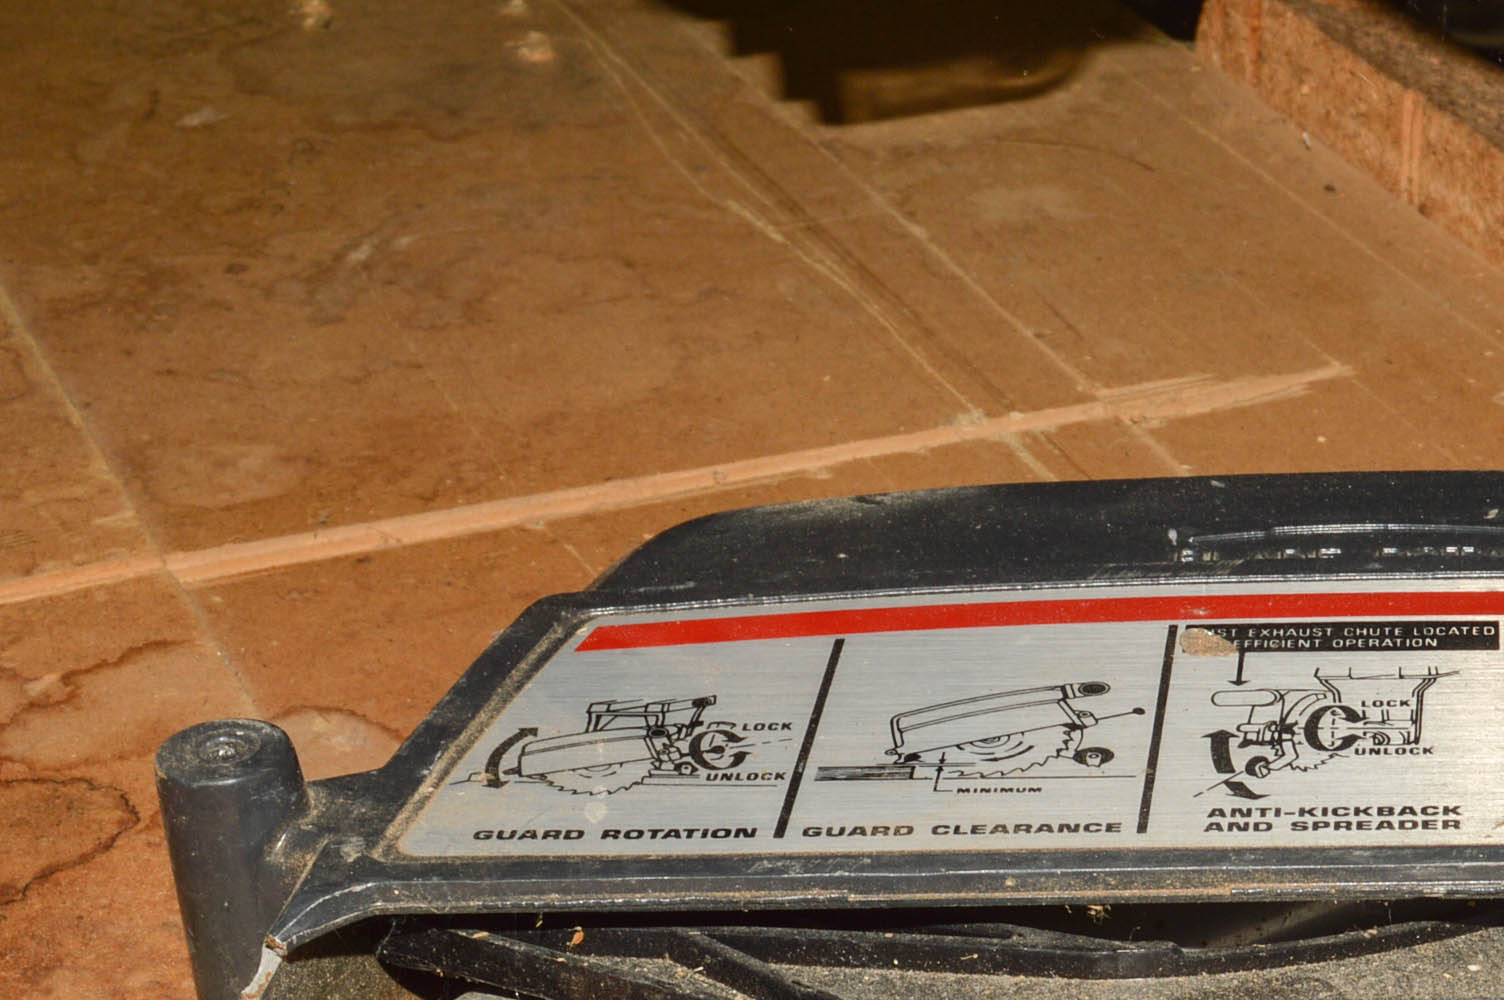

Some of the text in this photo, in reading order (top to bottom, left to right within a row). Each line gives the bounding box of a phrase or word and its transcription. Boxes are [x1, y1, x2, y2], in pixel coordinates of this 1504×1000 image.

[1248, 627, 1334, 637] EXHAUST
[1344, 626, 1403, 636] CHUTE
[1413, 626, 1496, 636] LOCATED
[1233, 638, 1438, 648] EFFICIENT OPERATION
[1360, 699, 1411, 708] LOCK
[741, 721, 793, 732] LOCK
[1353, 746, 1434, 756] UNLOCK
[704, 771, 787, 782] UNLOCK
[956, 786, 1043, 794] MINIMUM
[1206, 805, 1463, 818] ANTI-KICKBACK
[802, 822, 1123, 838] GUARD CLEARANCE
[1203, 819, 1462, 832] AND SPREADER
[472, 826, 759, 841] GUARD ROTATION
